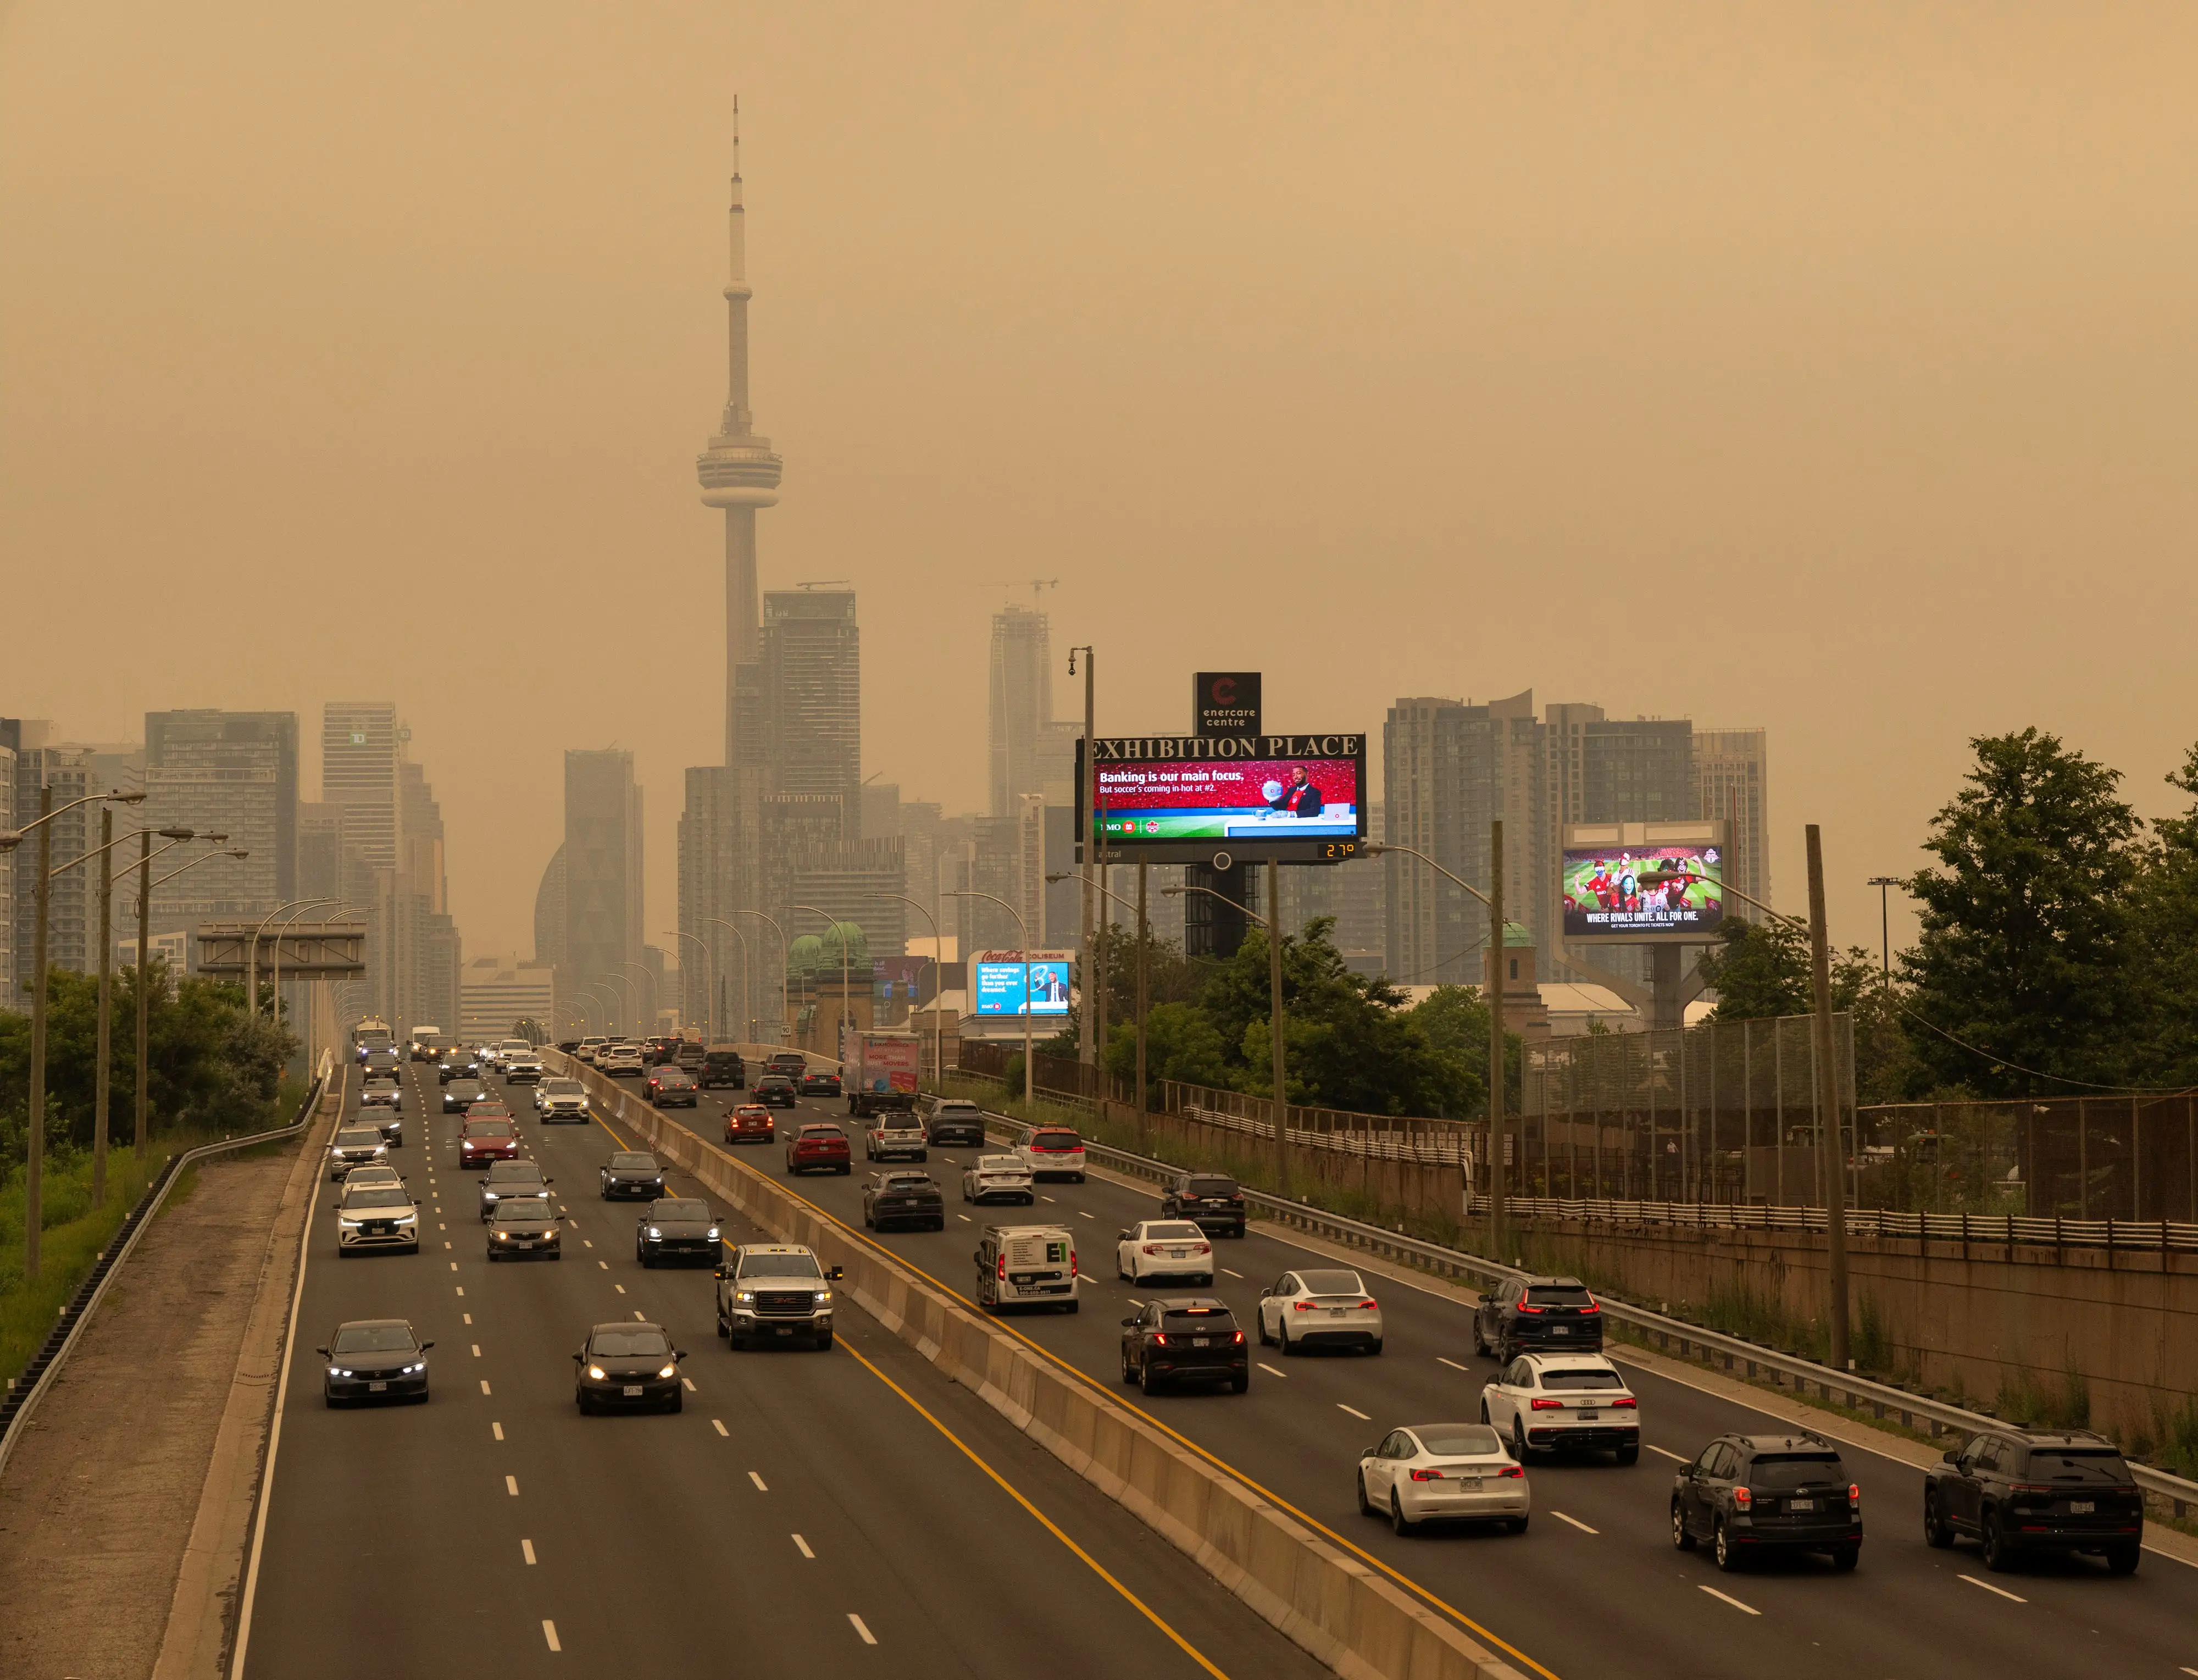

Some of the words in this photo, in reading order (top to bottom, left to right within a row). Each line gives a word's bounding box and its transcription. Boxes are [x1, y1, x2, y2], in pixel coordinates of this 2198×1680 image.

[351, 734, 365, 743] TD
[1093, 738, 1257, 759] EXHIBITION
[1267, 736, 1358, 757] PLACE
[1100, 772, 1146, 784] Banking
[1148, 771, 1158, 781] is
[1160, 773, 1179, 781] our
[1181, 770, 1209, 781] main
[1212, 770, 1245, 781] focus.
[1114, 784, 1142, 793] soccer's
[1144, 785, 1170, 794] coming
[1586, 913, 1609, 923] WHERE
[1611, 912, 1633, 922] RIVALS
[1634, 912, 1655, 922] UNITE.
[1656, 912, 1668, 921] ALL
[1669, 911, 1683, 921] FOR
[1683, 911, 1699, 921] ONE.
[981, 950, 1025, 963] Coca-Cola
